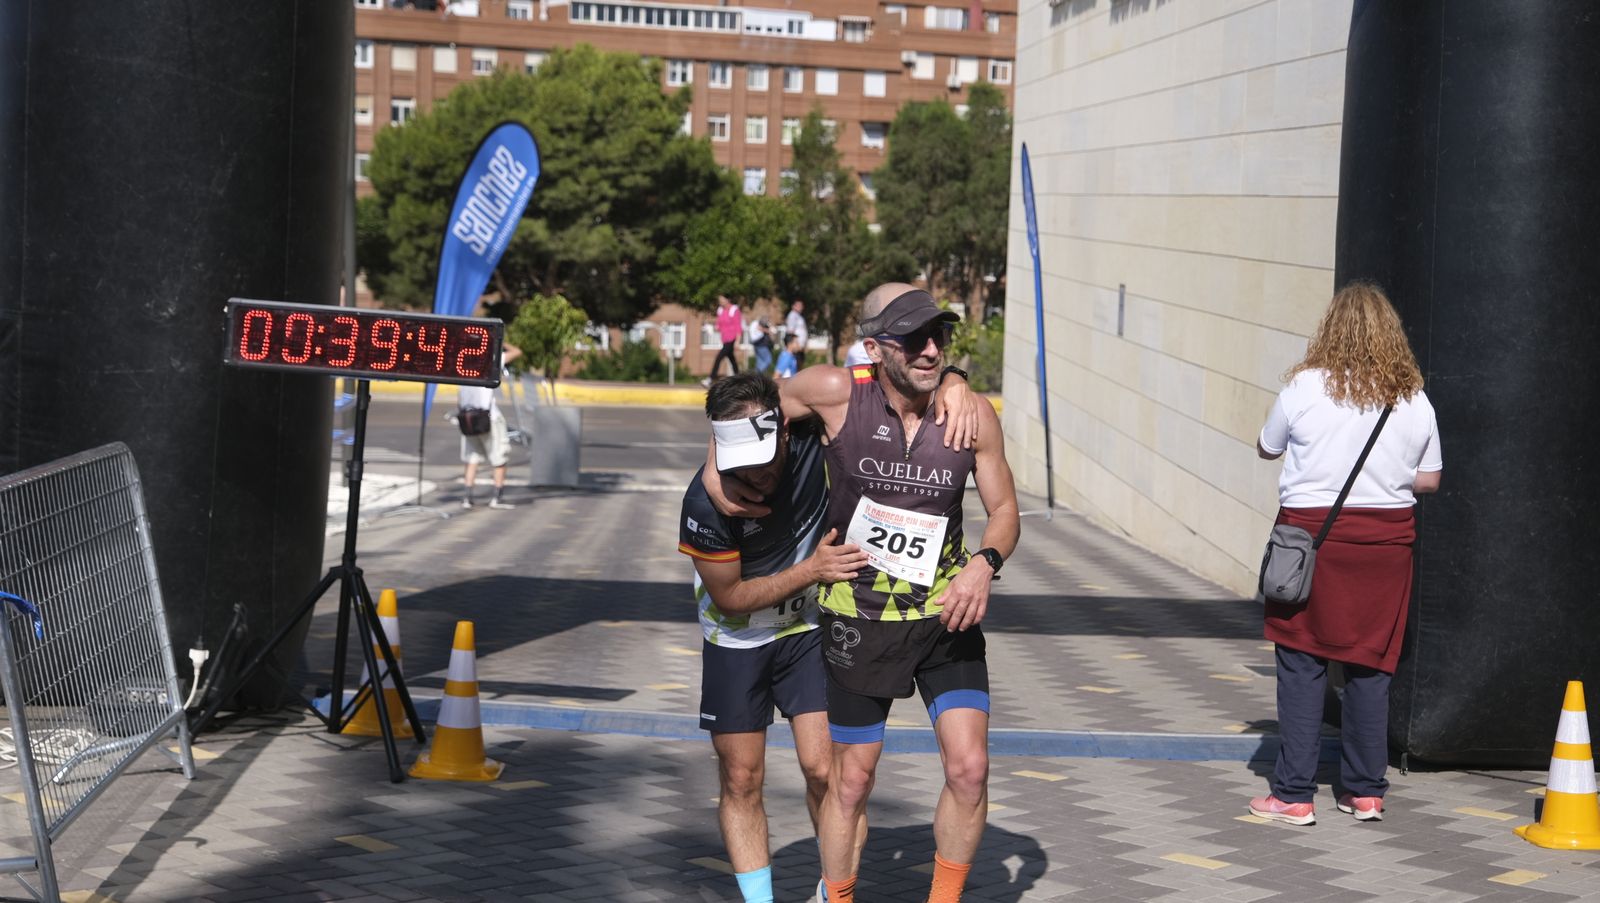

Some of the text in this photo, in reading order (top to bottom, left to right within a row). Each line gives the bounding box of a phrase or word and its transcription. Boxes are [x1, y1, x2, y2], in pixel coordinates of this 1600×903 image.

[240, 309, 488, 377] 00:39:42
[859, 457, 952, 486] CUELLAR
[868, 482, 908, 493] STONE
[866, 526, 927, 560] 205
